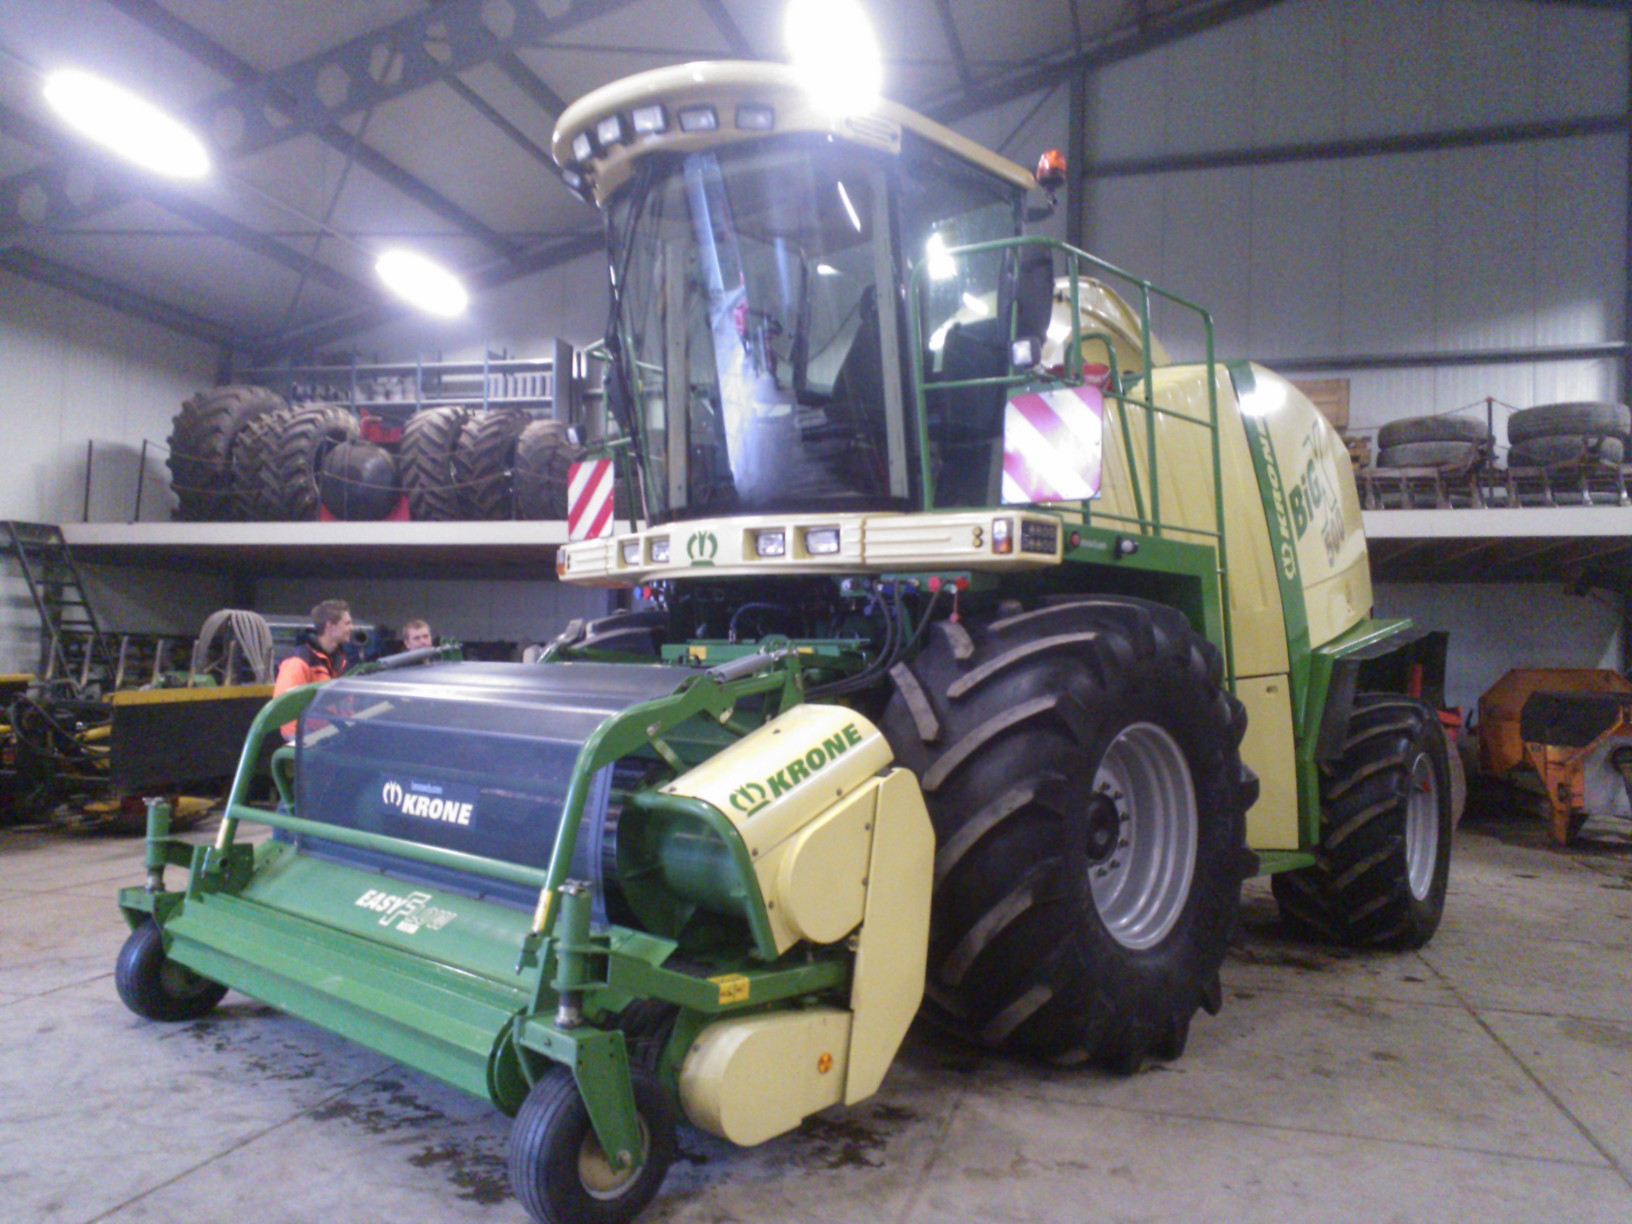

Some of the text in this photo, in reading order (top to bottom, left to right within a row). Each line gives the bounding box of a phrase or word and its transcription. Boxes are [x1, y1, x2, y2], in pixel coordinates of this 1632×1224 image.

[1289, 459, 1322, 541] BiG
[767, 723, 862, 798] KRONE
[401, 793, 473, 826] KRONE
